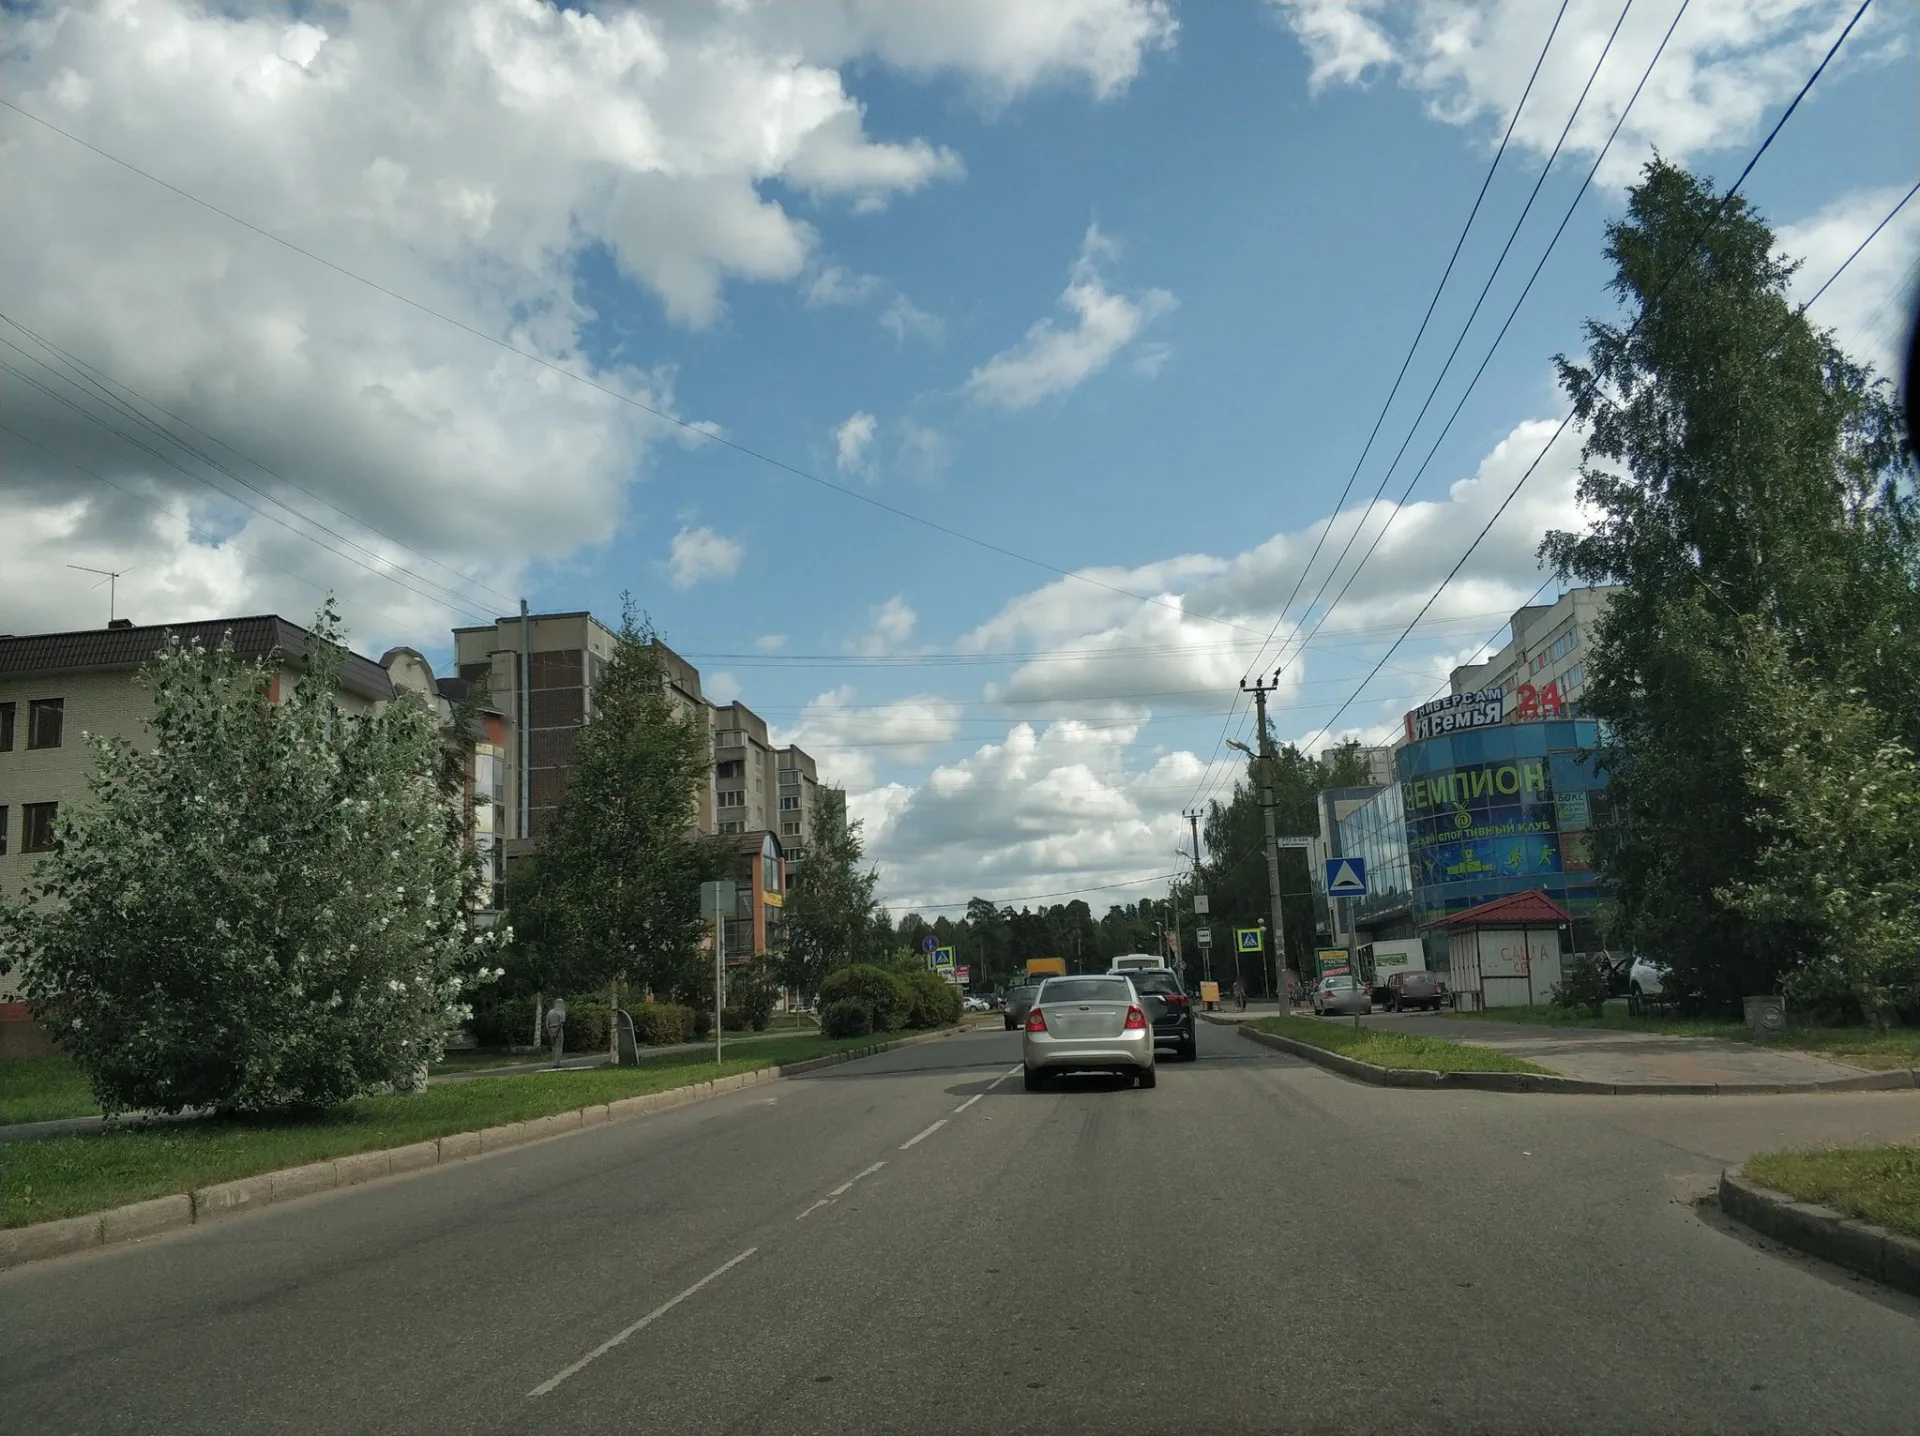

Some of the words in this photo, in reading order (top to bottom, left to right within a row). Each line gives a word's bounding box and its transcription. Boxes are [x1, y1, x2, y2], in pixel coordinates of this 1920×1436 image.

[1517, 682, 1561, 711] 24
[1406, 764, 1545, 809] ЧЕМПИОН
[1558, 792, 1584, 802] БОКС
[1518, 821, 1550, 832] КЛУБ
